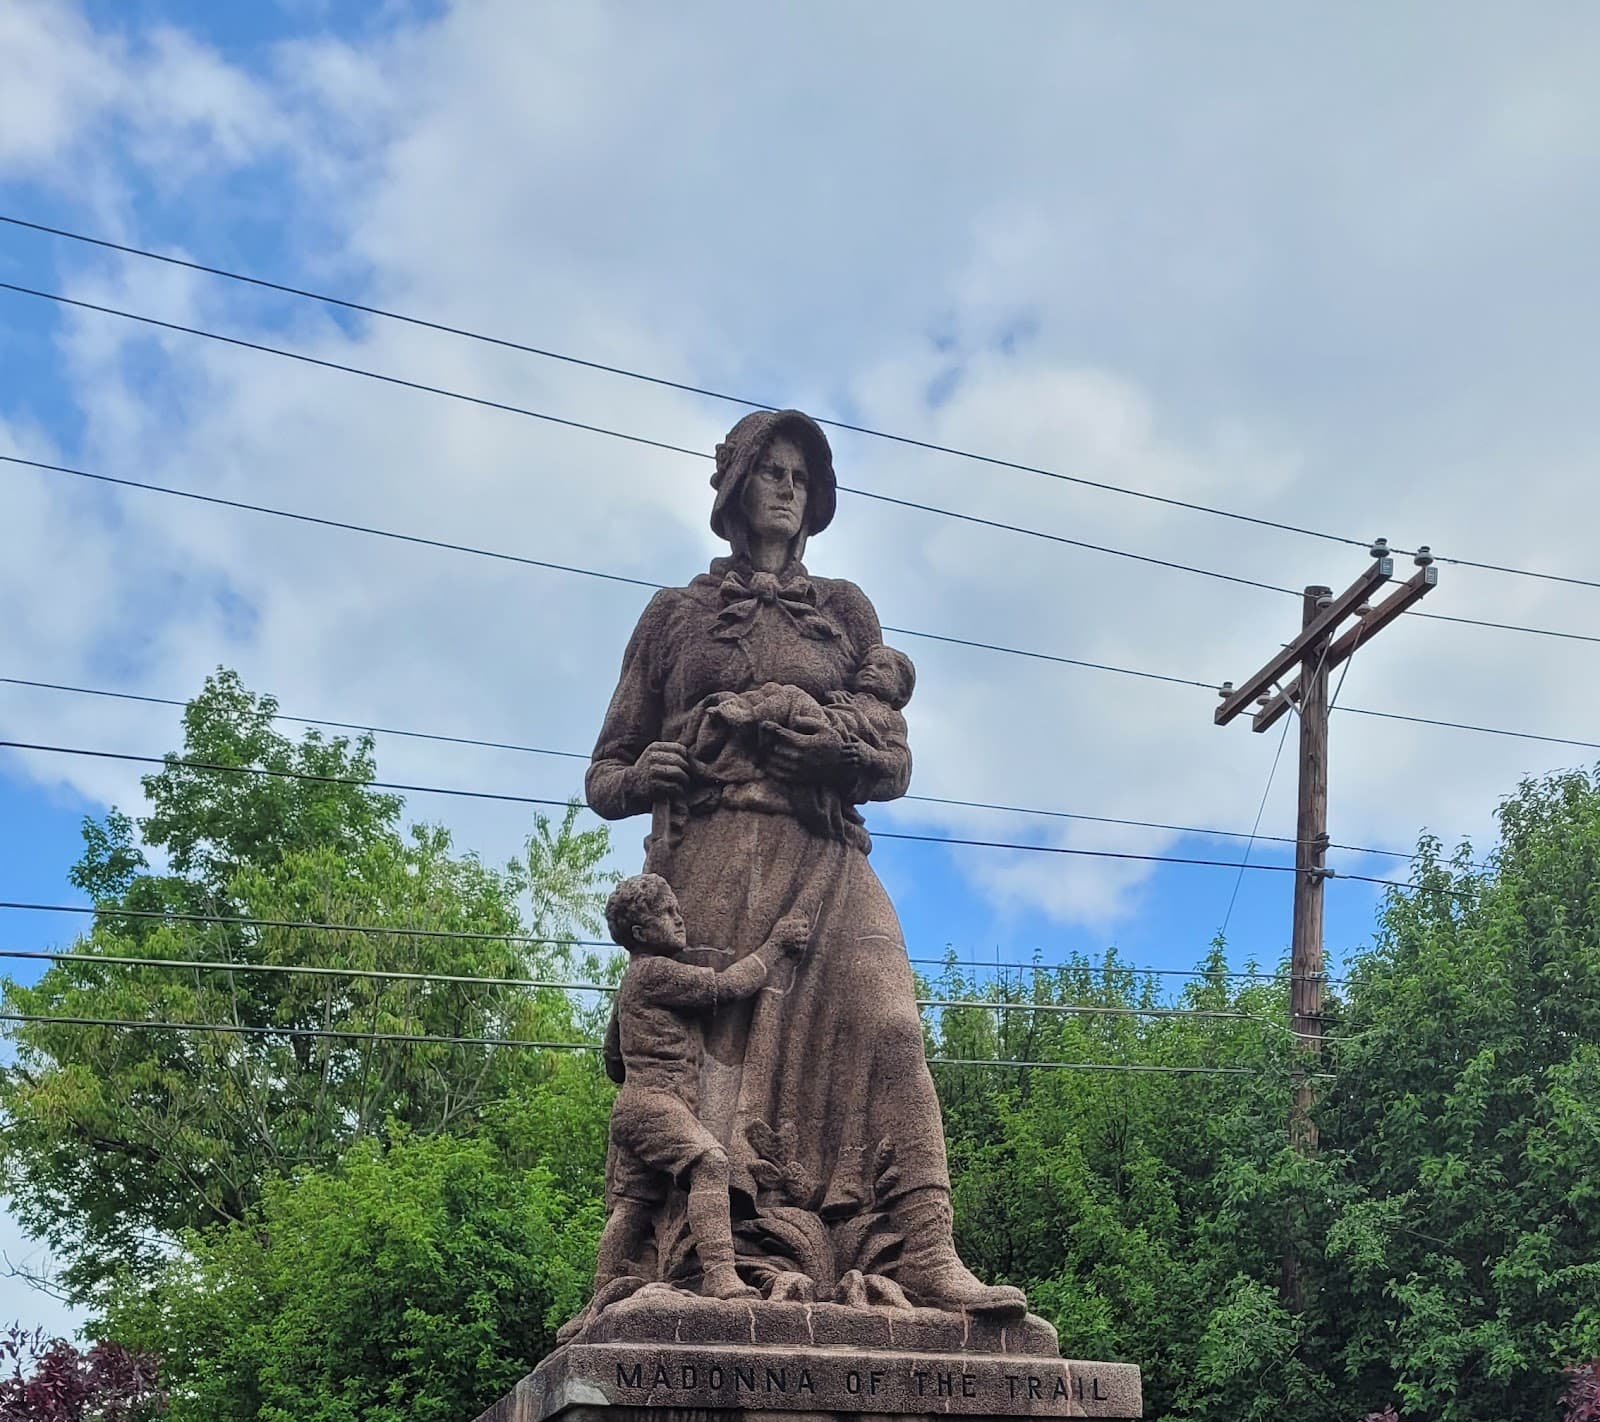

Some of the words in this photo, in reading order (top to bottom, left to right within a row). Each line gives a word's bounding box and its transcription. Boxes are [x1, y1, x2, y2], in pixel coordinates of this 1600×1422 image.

[616, 1363, 815, 1394] MADONNA
[846, 1370, 885, 1396] OF
[914, 1371, 977, 1398] THE
[1005, 1375, 1108, 1401] TRAIL
